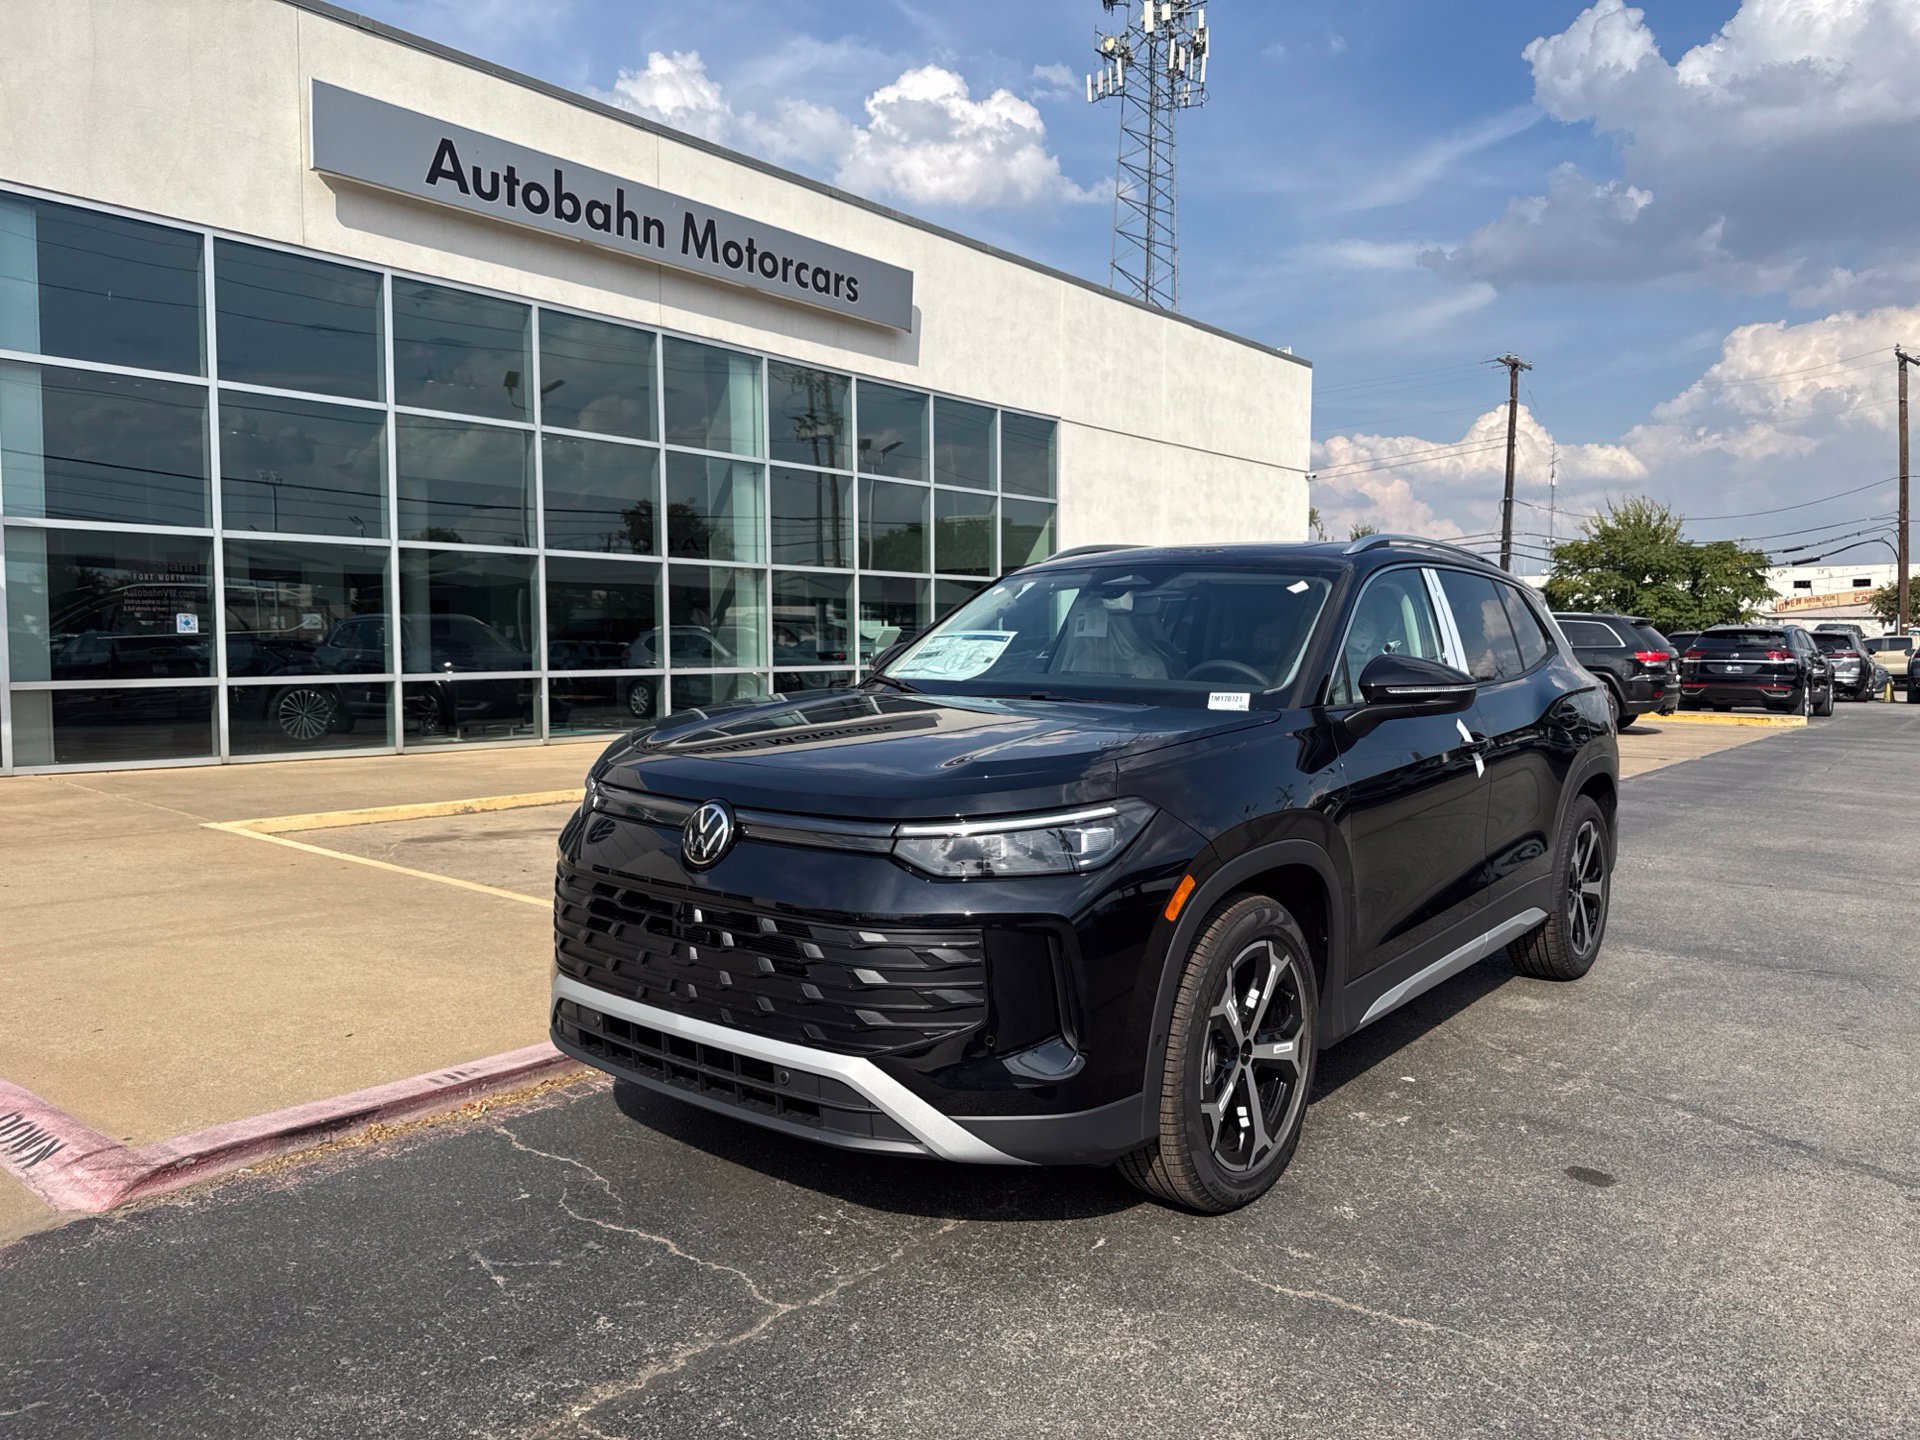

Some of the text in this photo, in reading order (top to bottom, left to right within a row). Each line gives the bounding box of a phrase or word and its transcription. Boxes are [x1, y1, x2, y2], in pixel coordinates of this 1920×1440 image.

[425, 138, 859, 303] Autobahn Motorcars
[133, 573, 186, 582] FORT WORTH
[123, 588, 196, 599] AutobahnVW.com
